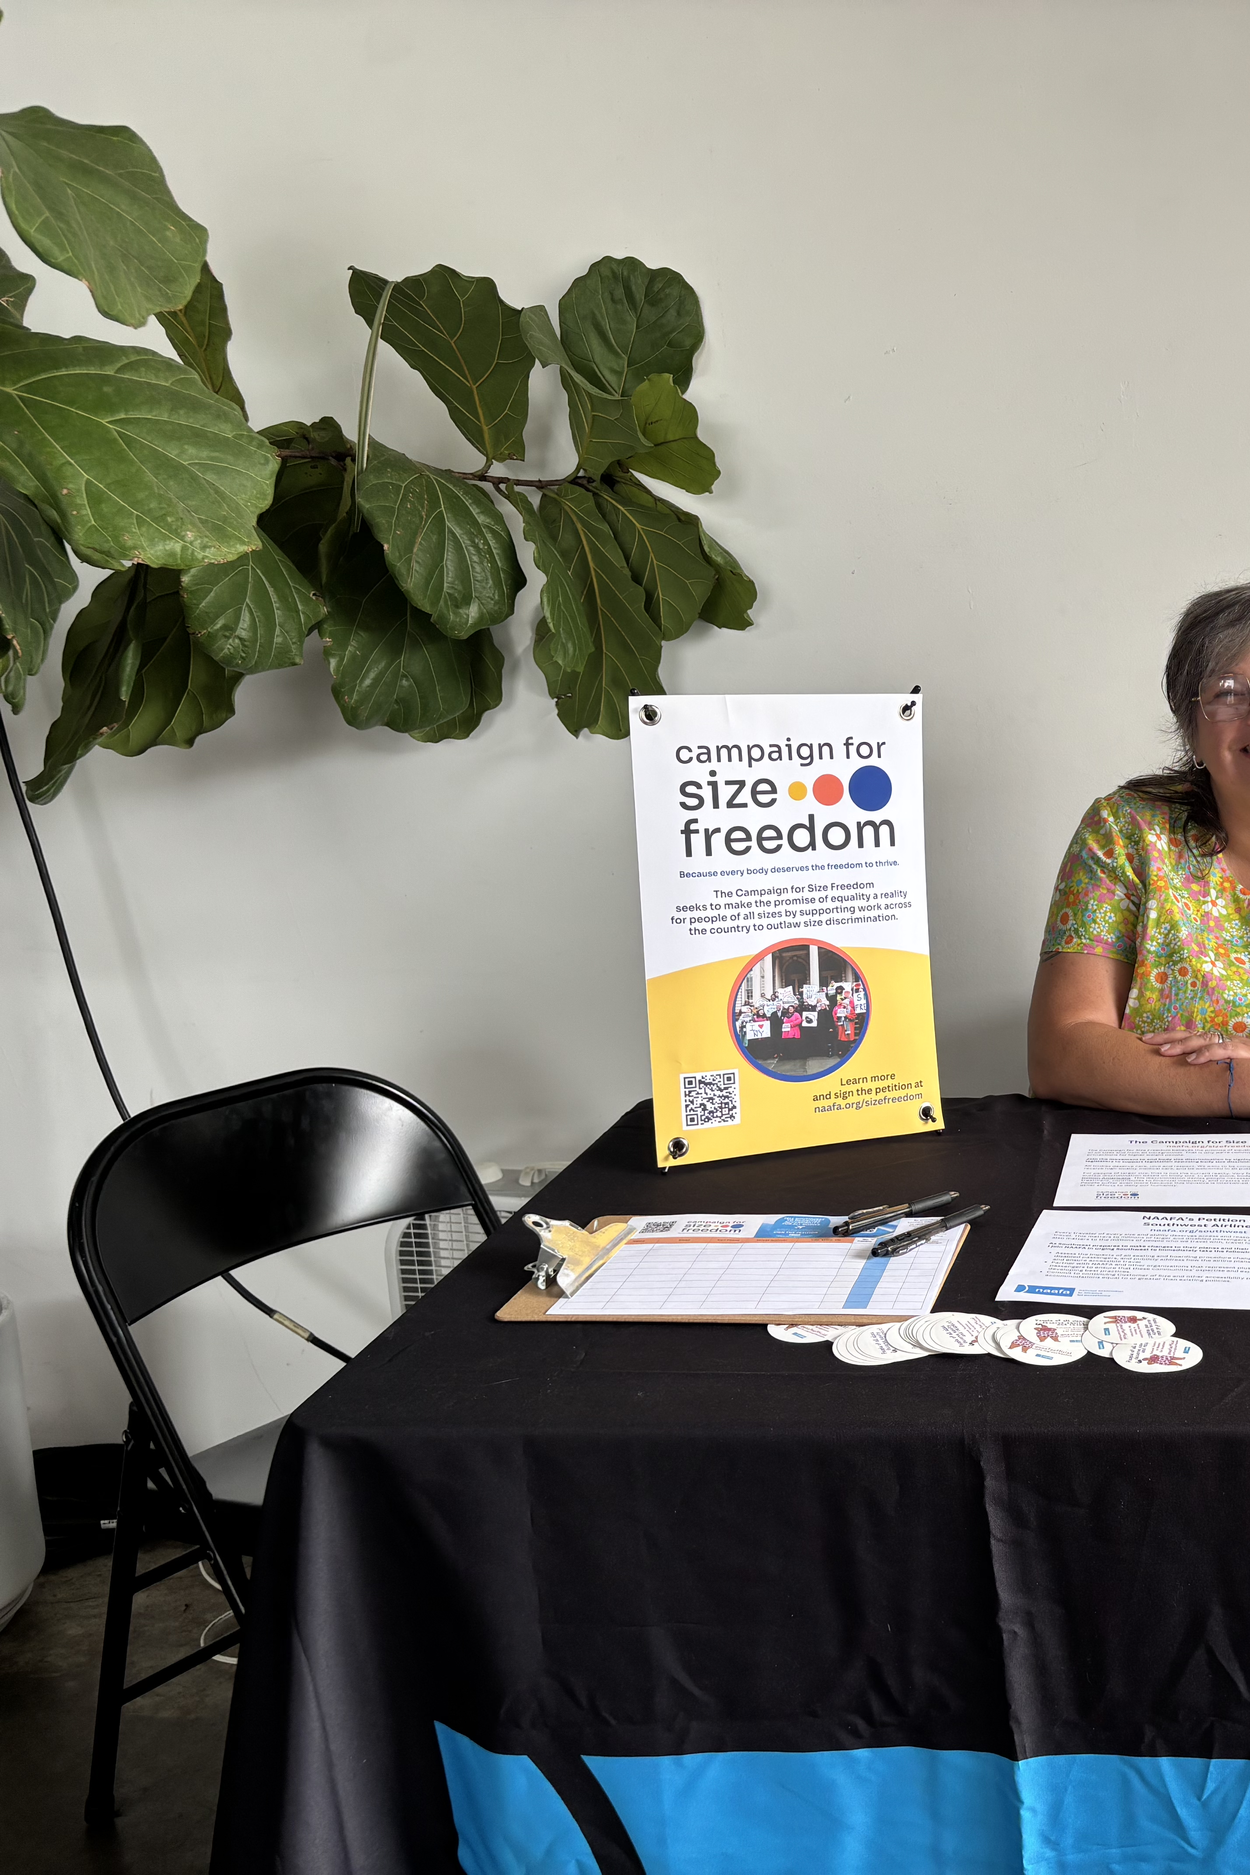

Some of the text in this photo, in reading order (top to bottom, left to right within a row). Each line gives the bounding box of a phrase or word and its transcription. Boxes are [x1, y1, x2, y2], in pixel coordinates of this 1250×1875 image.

[675, 736, 886, 768] campaign for
[679, 770, 778, 811] size
[680, 814, 895, 857] freedom
[679, 869, 718, 879] Because
[720, 868, 745, 878] every
[746, 866, 769, 877] body
[770, 864, 810, 875] deserves
[811, 863, 826, 872] the
[827, 861, 863, 870] freedom
[875, 859, 900, 868] thrive.
[675, 903, 708, 913] seeks
[710, 902, 722, 911] to
[724, 900, 753, 910] make
[754, 898, 772, 909] the
[774, 895, 816, 909] promise
[818, 894, 829, 903] of
[830, 890, 871, 905] equality
[880, 889, 908, 901] reality
[714, 880, 875, 899] The Campaign for Size Freedom
[670, 900, 912, 925] for people of all sizes by supporting work across
[688, 912, 899, 937] the country to outlaw size discrimination.
[812, 1080, 924, 1102] and sign the petition at
[840, 1072, 896, 1086] Learn more
[814, 1091, 923, 1114] naafa.org/sizefreedom
